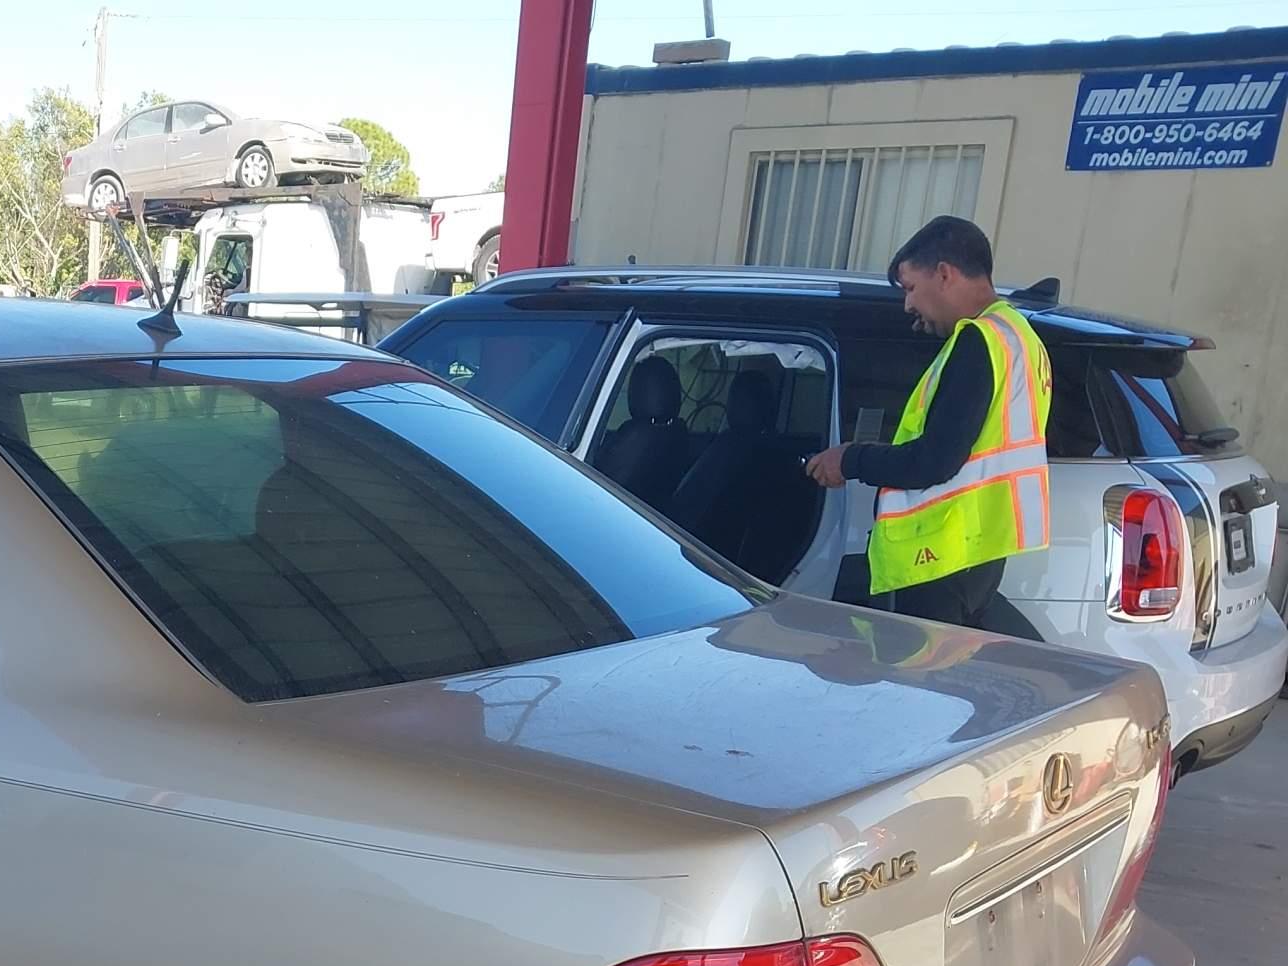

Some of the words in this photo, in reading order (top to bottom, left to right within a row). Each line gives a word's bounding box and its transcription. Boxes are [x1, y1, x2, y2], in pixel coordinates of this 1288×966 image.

[1079, 71, 1197, 117] mobile
[1194, 71, 1286, 113] mini
[1083, 120, 1265, 145] 1-800-950-6464
[1088, 147, 1248, 167] mobilemini.com
[818, 850, 918, 908] LEXUS
